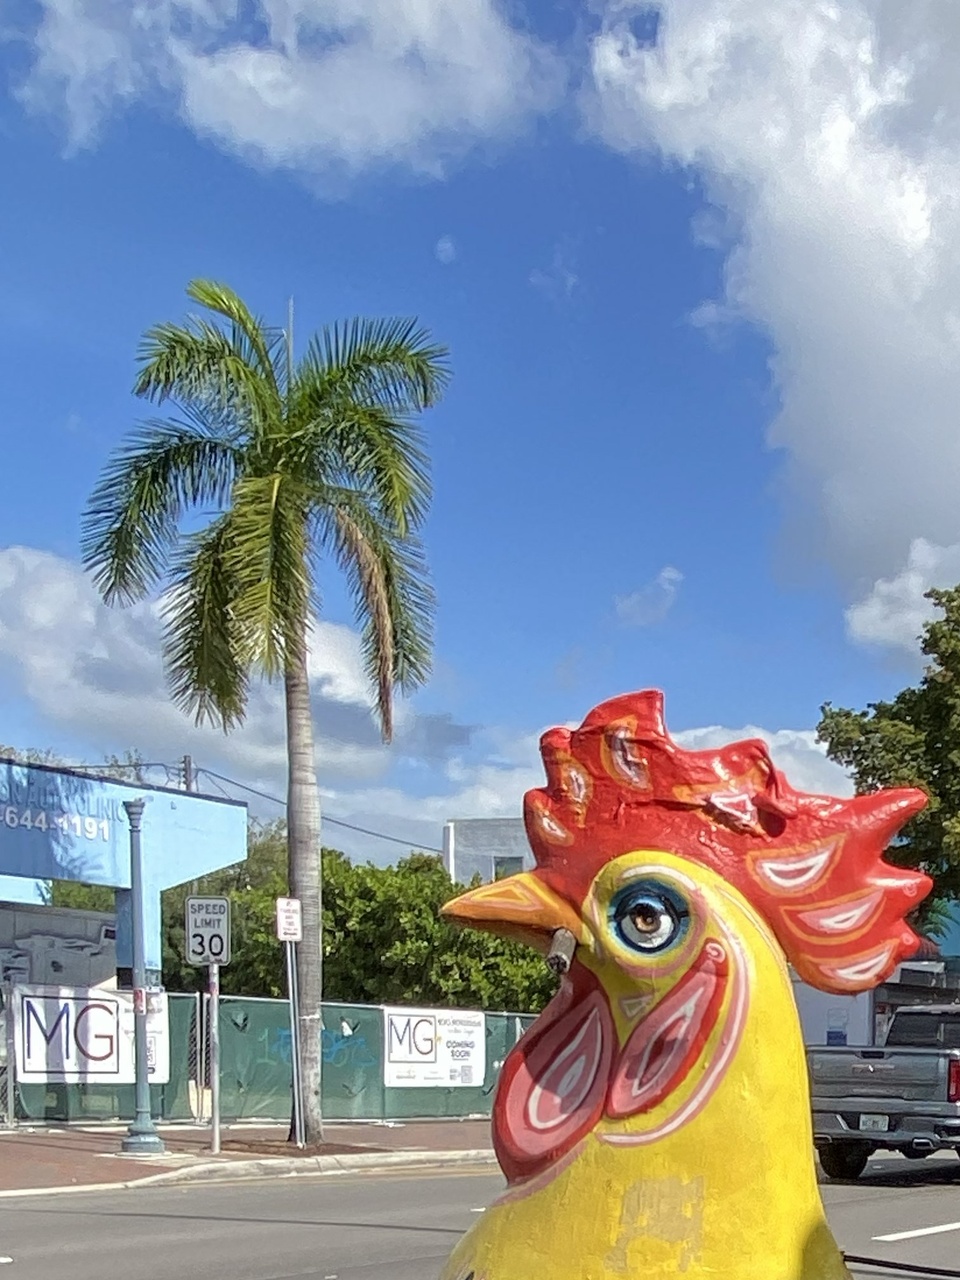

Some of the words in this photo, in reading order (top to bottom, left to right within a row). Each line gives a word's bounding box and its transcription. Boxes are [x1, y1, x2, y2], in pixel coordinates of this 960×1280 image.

[190, 903, 226, 915] SPEED
[194, 918, 221, 929] LIMIT
[192, 933, 224, 956] 30
[26, 999, 114, 1061] MG
[389, 1017, 433, 1055] MG
